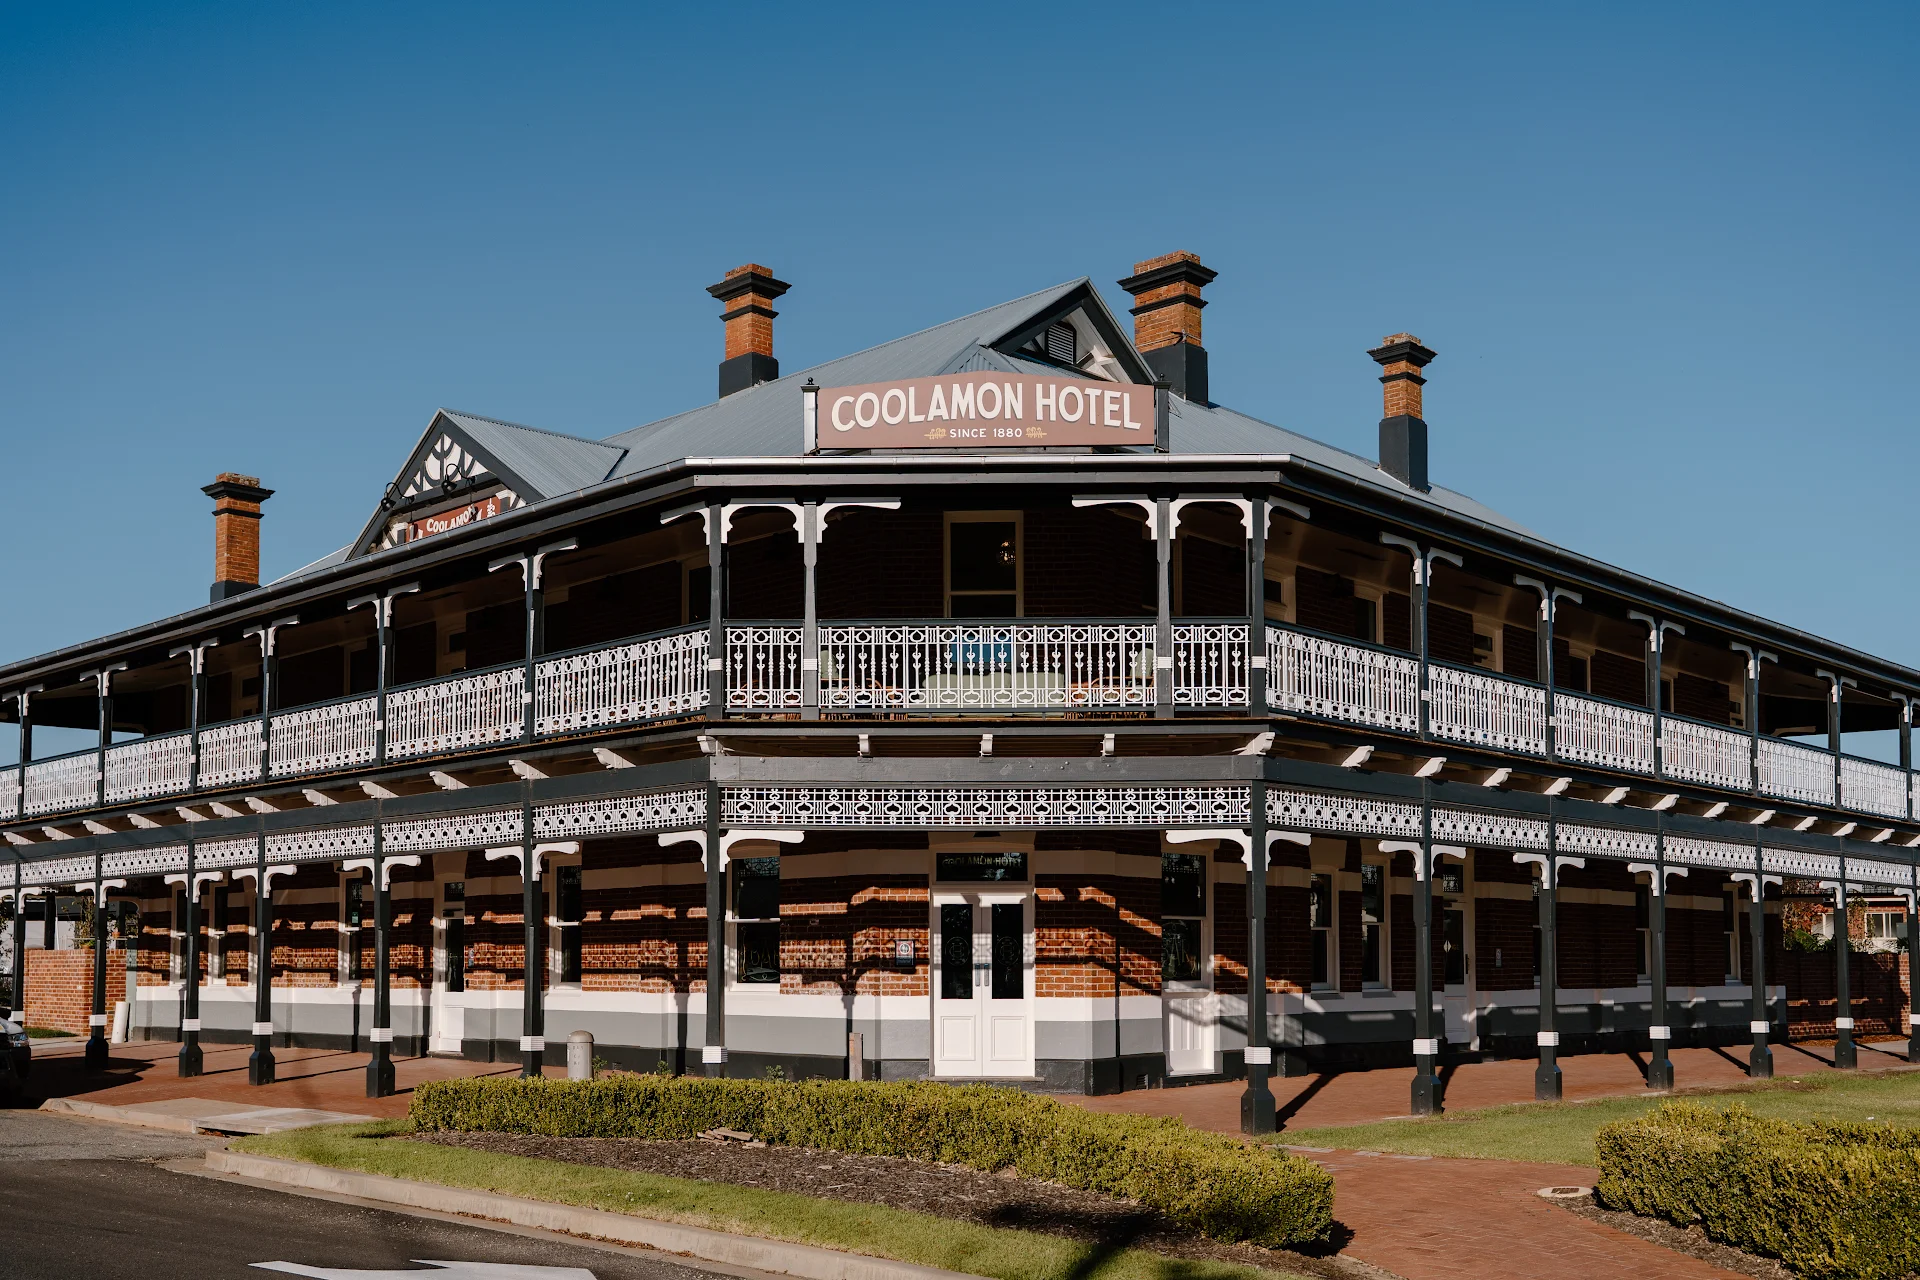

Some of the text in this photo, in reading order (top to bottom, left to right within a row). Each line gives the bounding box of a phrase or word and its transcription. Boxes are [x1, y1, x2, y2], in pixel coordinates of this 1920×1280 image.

[831, 382, 1142, 432] COOLAMON HOTEL
[950, 427, 1023, 438] SINCE 1880
